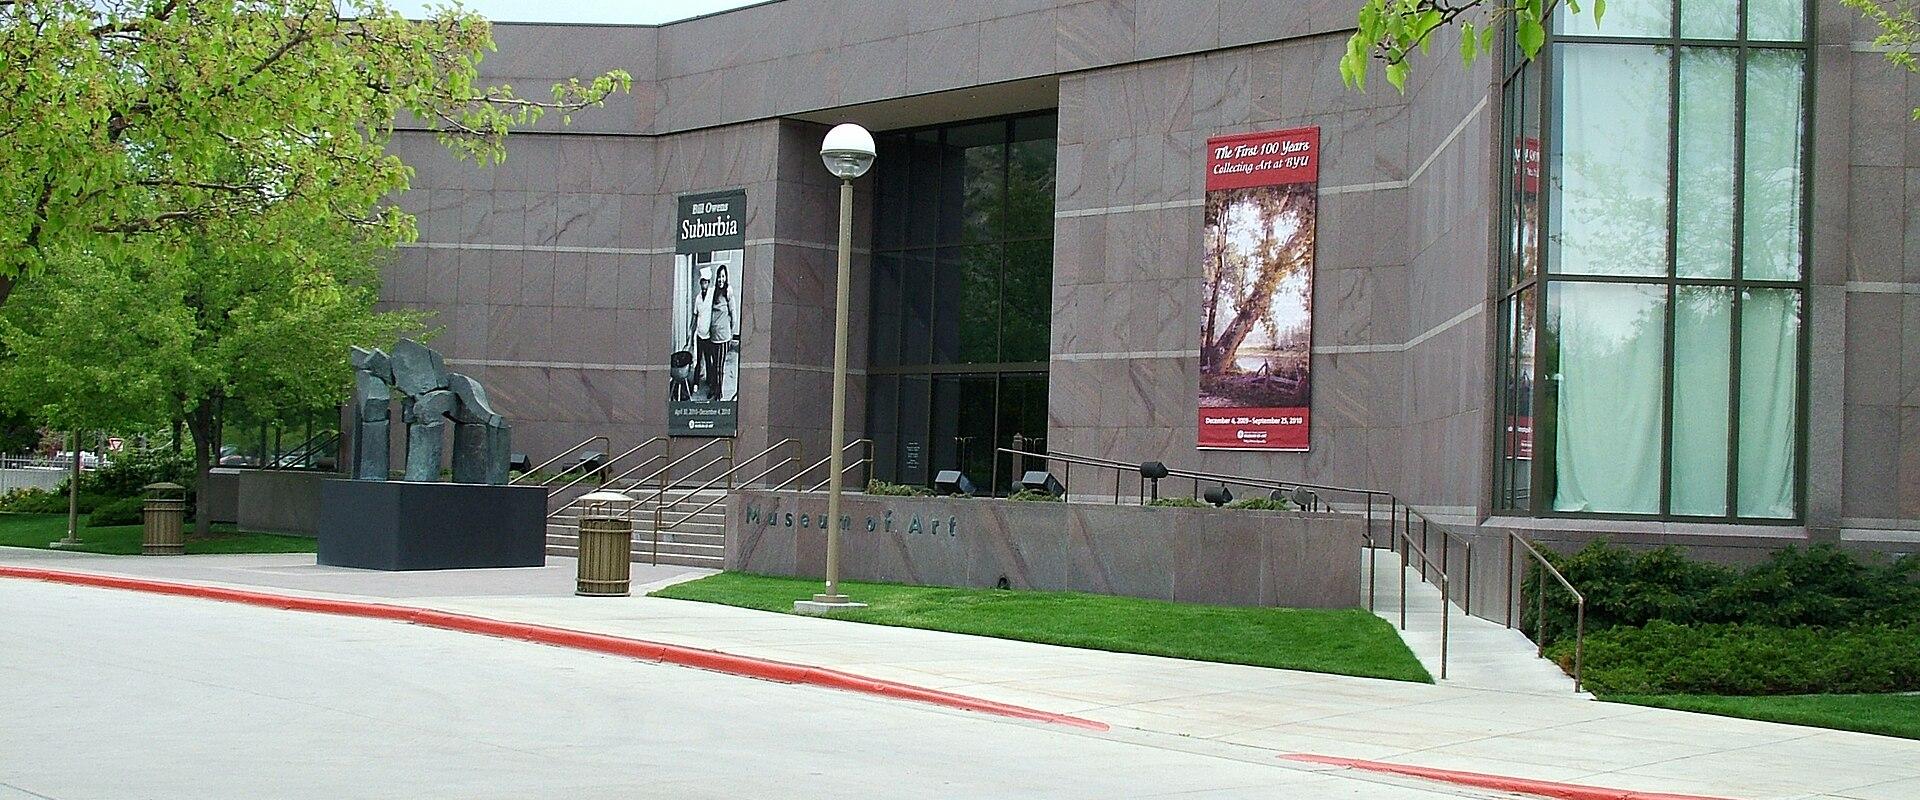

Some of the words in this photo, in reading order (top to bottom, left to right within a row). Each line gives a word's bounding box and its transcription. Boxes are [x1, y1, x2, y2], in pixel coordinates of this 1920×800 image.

[1214, 145, 1233, 160] The
[1234, 144, 1259, 159] First
[1260, 141, 1279, 155] 100
[1280, 140, 1310, 156] Years
[1213, 160, 1254, 175] Collecting
[1255, 159, 1272, 171] Art
[1272, 159, 1284, 169] at
[1284, 156, 1310, 170] BYU
[692, 203, 705, 215] Bill
[705, 202, 729, 213] Owens
[681, 214, 738, 240] Suburbia
[1205, 416, 1231, 425] December
[746, 506, 851, 531] Museum
[865, 510, 894, 533] of
[908, 513, 957, 537] Art
